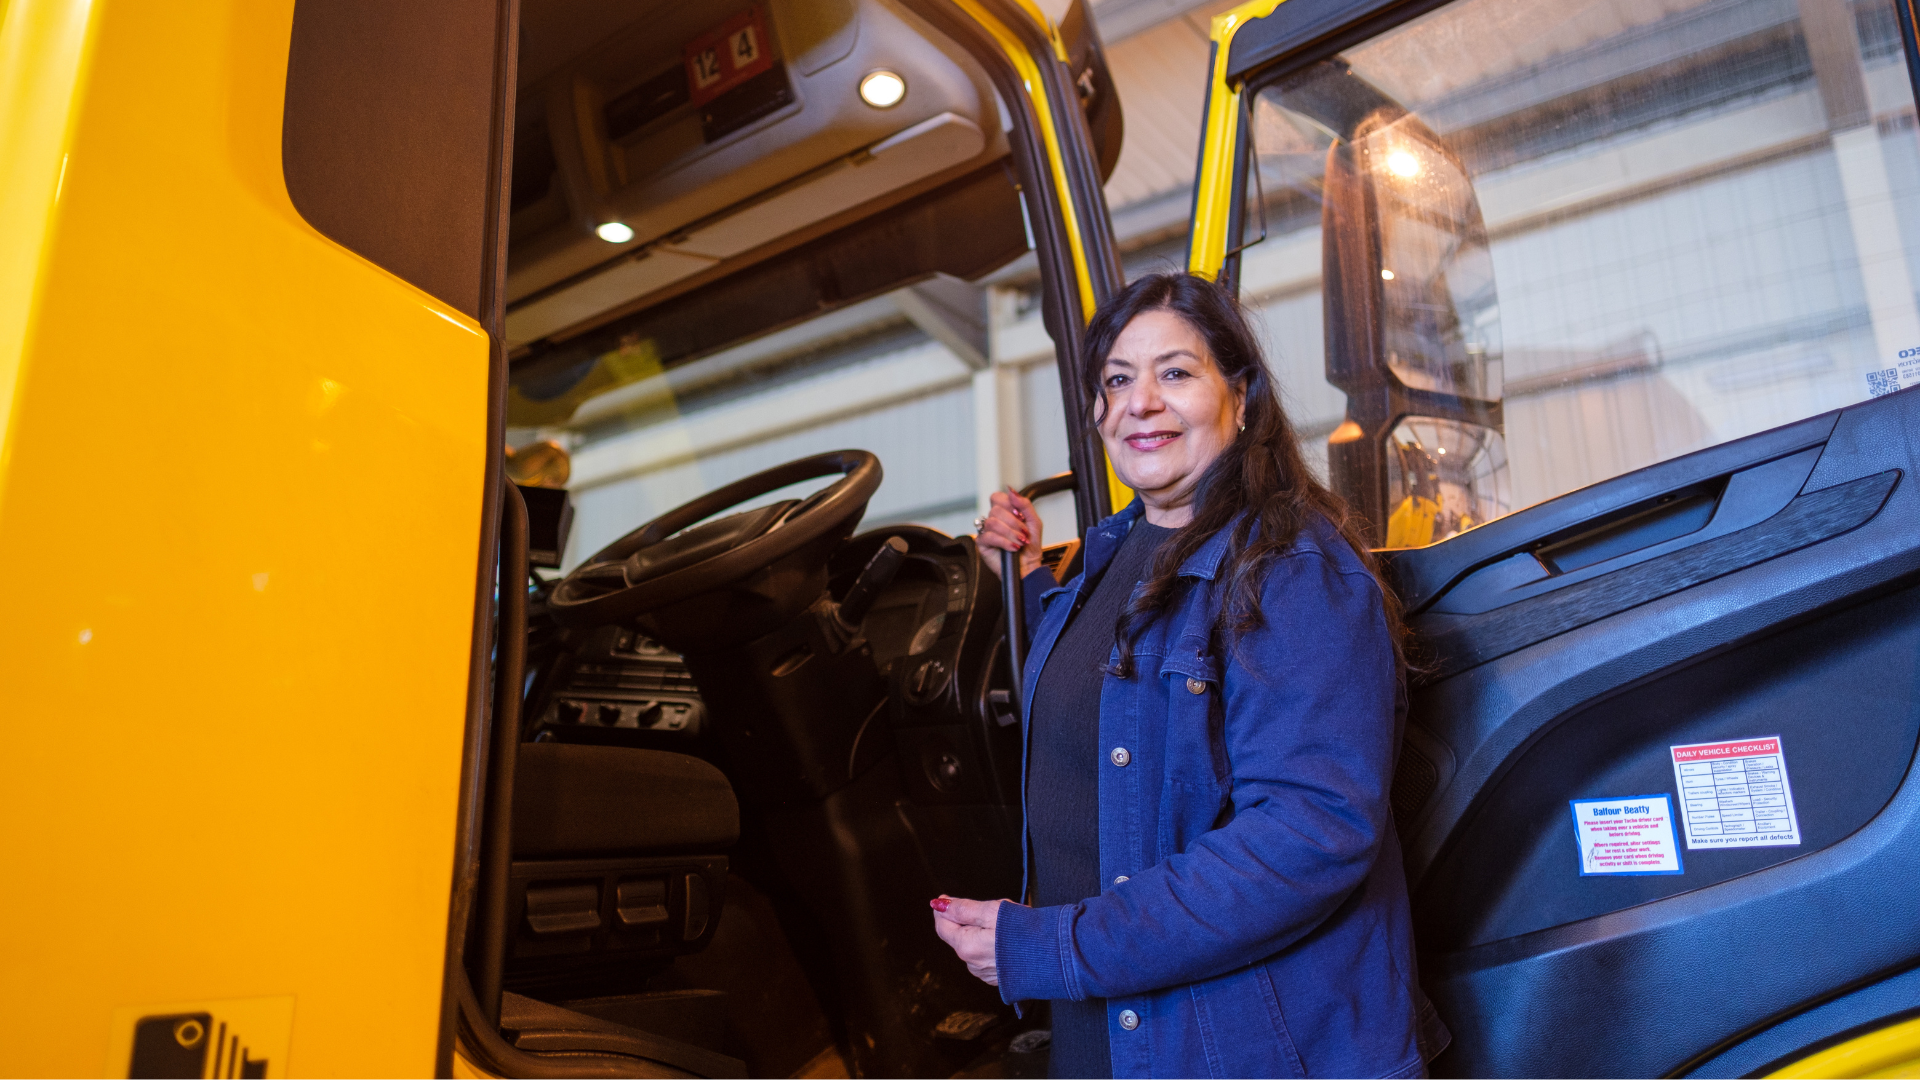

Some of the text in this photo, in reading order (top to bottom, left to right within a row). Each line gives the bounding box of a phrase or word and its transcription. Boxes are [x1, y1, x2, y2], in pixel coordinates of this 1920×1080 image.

[695, 30, 752, 80] 12 4
[1698, 747, 1730, 755] VEHICLE
[1732, 743, 1776, 752] CHECKLIST
[1593, 804, 1650, 816] Balfour Beatty
